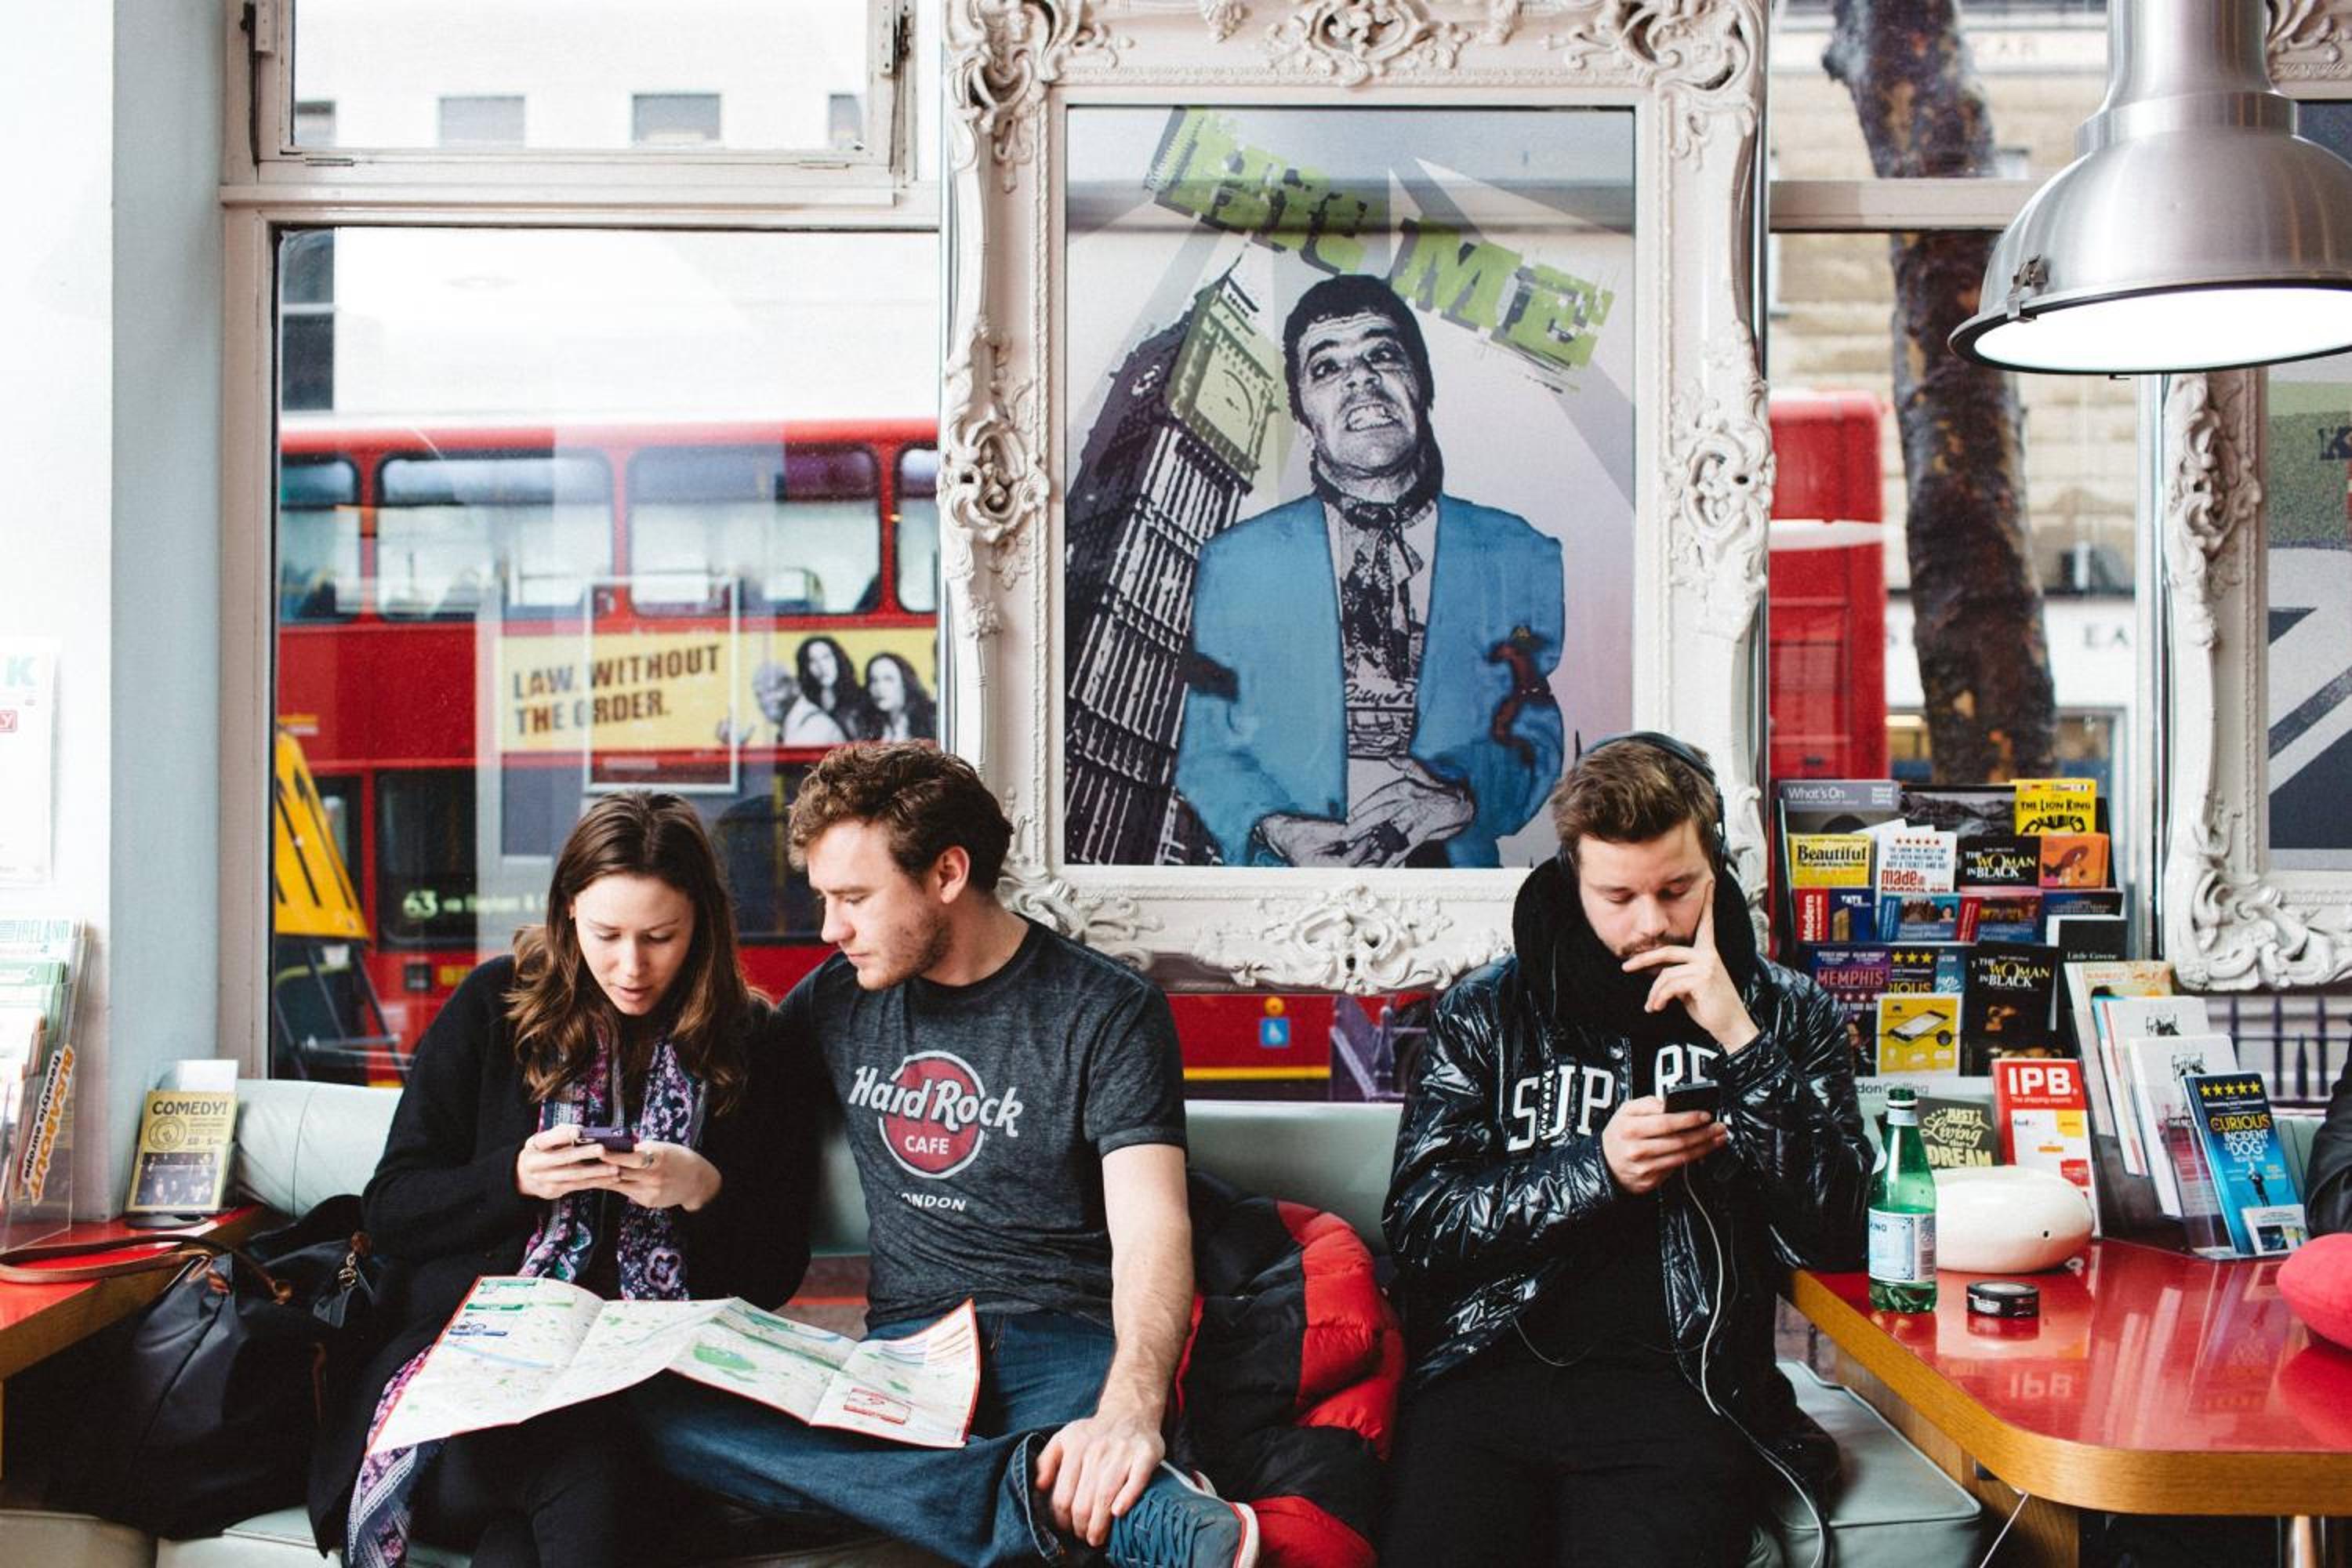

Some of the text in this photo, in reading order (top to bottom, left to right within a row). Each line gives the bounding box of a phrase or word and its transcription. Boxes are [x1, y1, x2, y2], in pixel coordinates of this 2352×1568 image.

[590, 644, 720, 688] WITHOUT
[515, 702, 564, 735] THE
[1787, 787, 1845, 800] What's On
[2020, 799, 2092, 812] THE LION KING
[1798, 844, 1867, 860] Beautiful
[1976, 853, 2036, 869] WOMAN
[1882, 869, 1918, 886] made
[1976, 866, 2020, 879] BLACK
[403, 889, 438, 919] 63
[1817, 969, 1885, 985] MEMPHIS
[1990, 960, 2051, 979] WOMAN
[1988, 974, 2032, 988] BLACK
[848, 1065, 1024, 1138] Hard Rock
[2210, 1114, 2271, 1131] CURIOUS
[1921, 1116, 1983, 1149] Living
[2223, 1129, 2269, 1142] INCIDENT
[905, 1135, 949, 1155] CAFE
[2230, 1141, 2264, 1156] DOG
[1926, 1144, 1993, 1167] DREAM
[895, 1191, 967, 1212] ONDON
